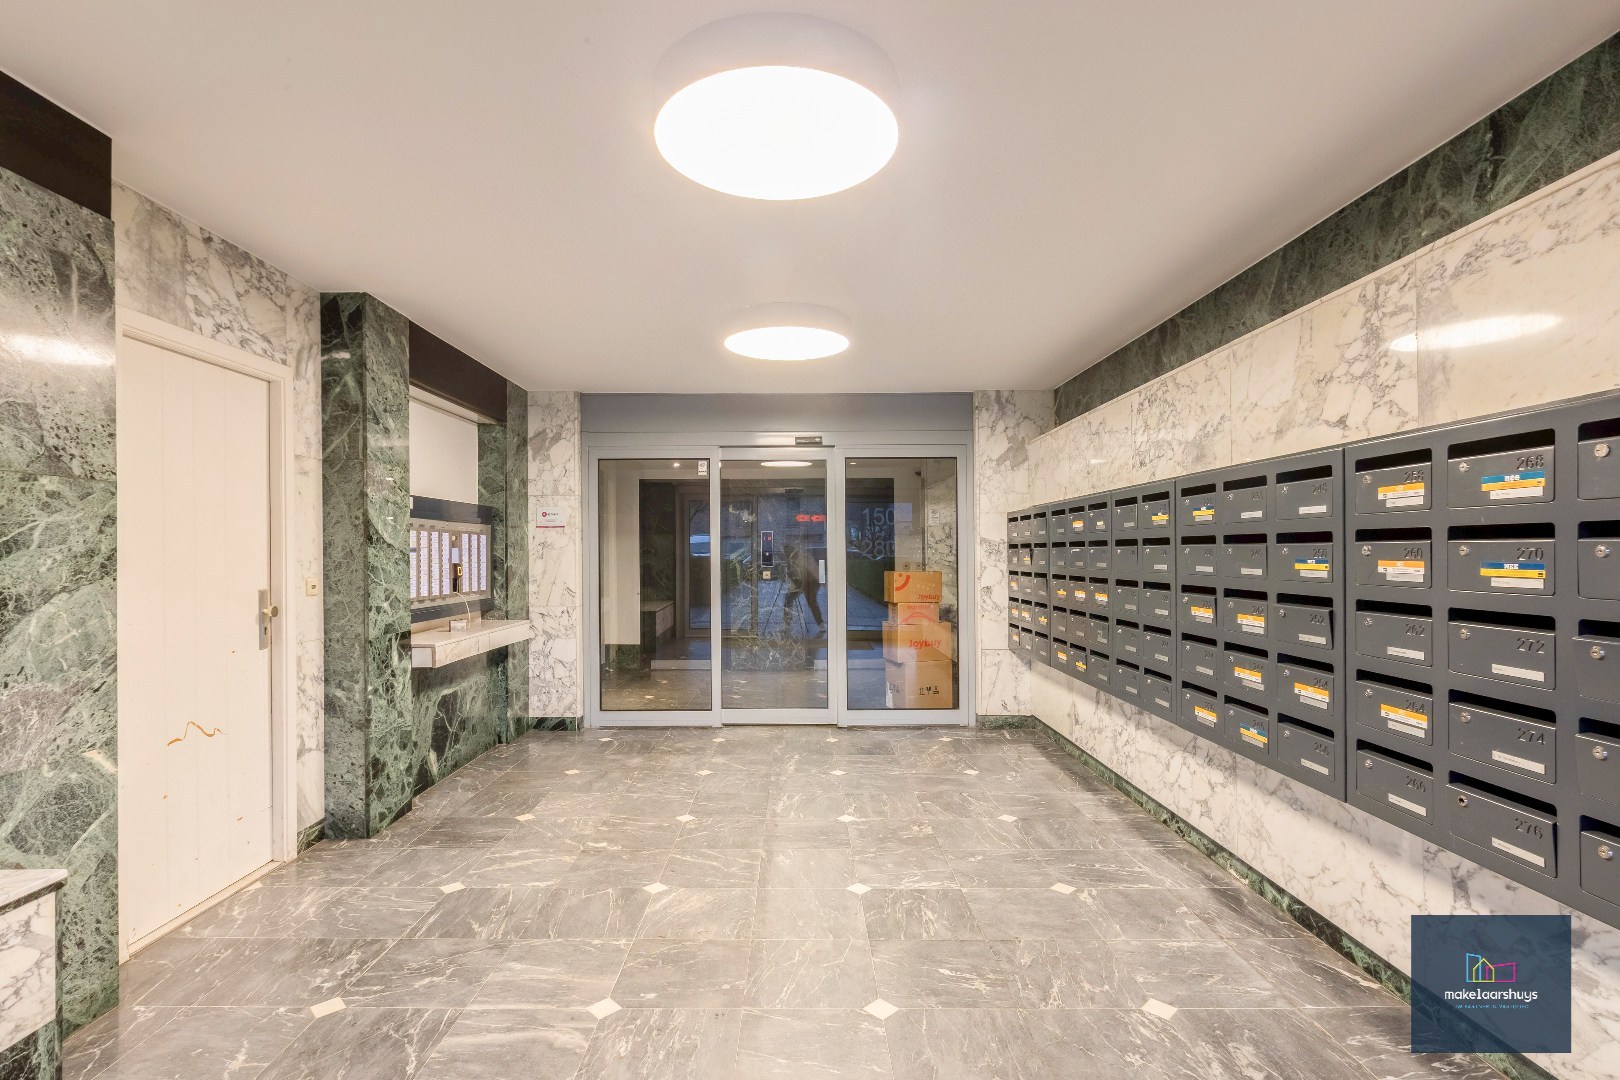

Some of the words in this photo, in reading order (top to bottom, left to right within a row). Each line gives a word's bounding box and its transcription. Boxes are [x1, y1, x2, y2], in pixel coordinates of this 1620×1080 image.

[1516, 454, 1545, 471] 268
[1404, 547, 1423, 559] 260
[1516, 547, 1544, 561] 270
[1405, 623, 1425, 637] 262
[1516, 637, 1545, 655] 272
[1516, 727, 1546, 746] 274
[1405, 775, 1426, 793] 266
[1514, 817, 1543, 840] 276
